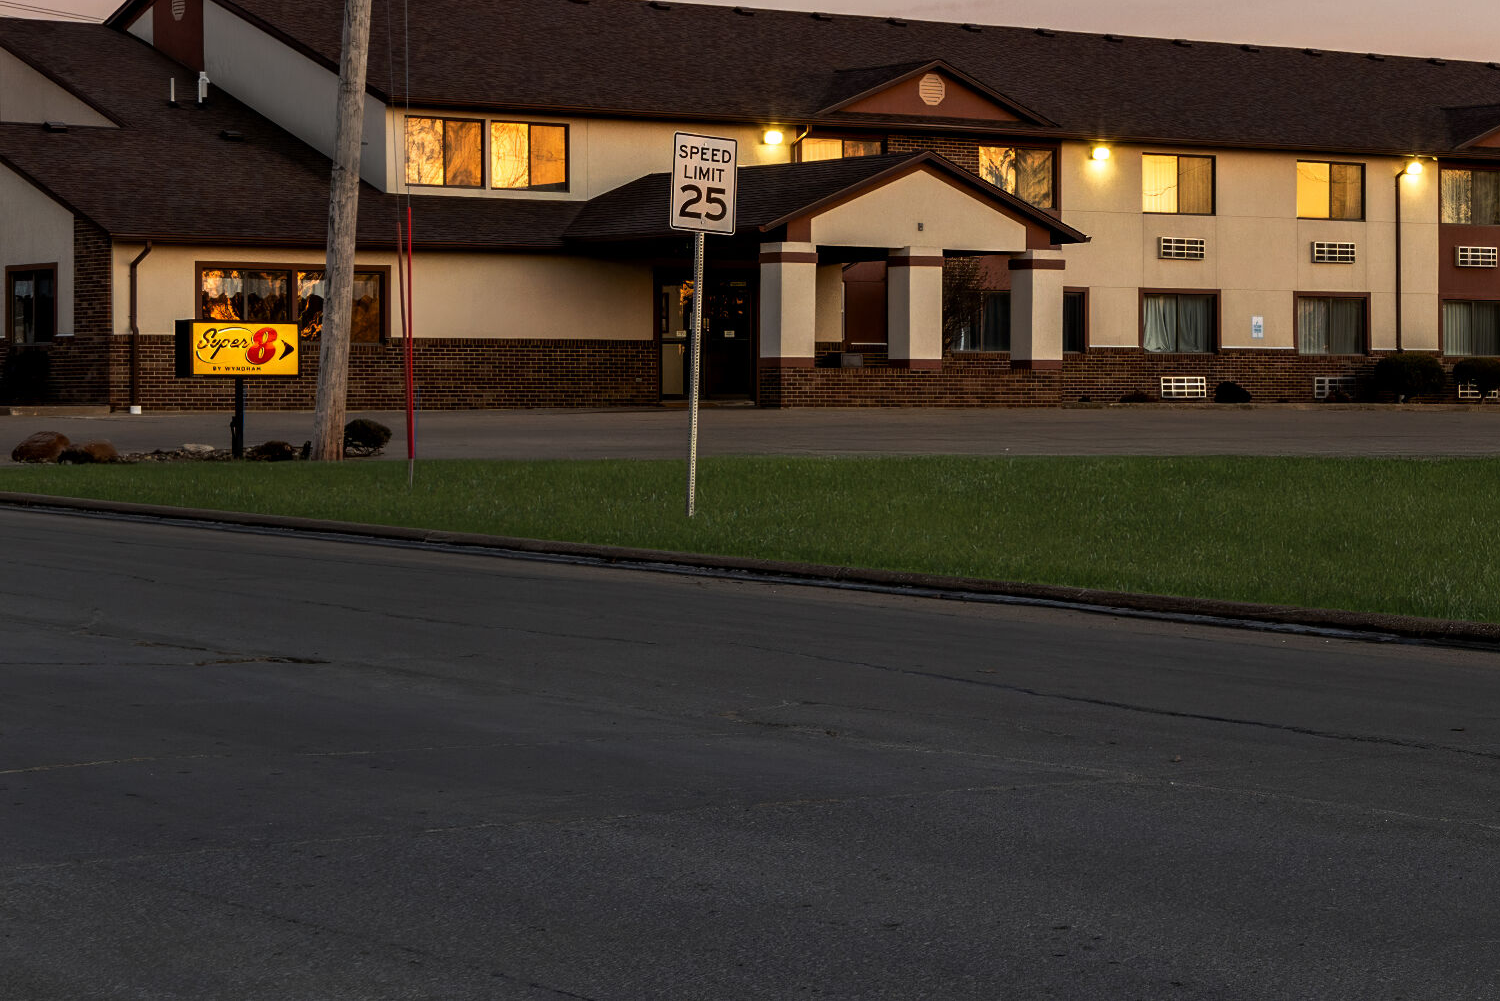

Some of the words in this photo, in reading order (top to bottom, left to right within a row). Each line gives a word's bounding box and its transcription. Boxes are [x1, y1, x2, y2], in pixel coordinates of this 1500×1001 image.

[679, 144, 731, 163] SPEED
[684, 164, 725, 182] LIMIT
[679, 184, 727, 221] 25
[196, 327, 251, 360] Super
[245, 327, 277, 365] 8
